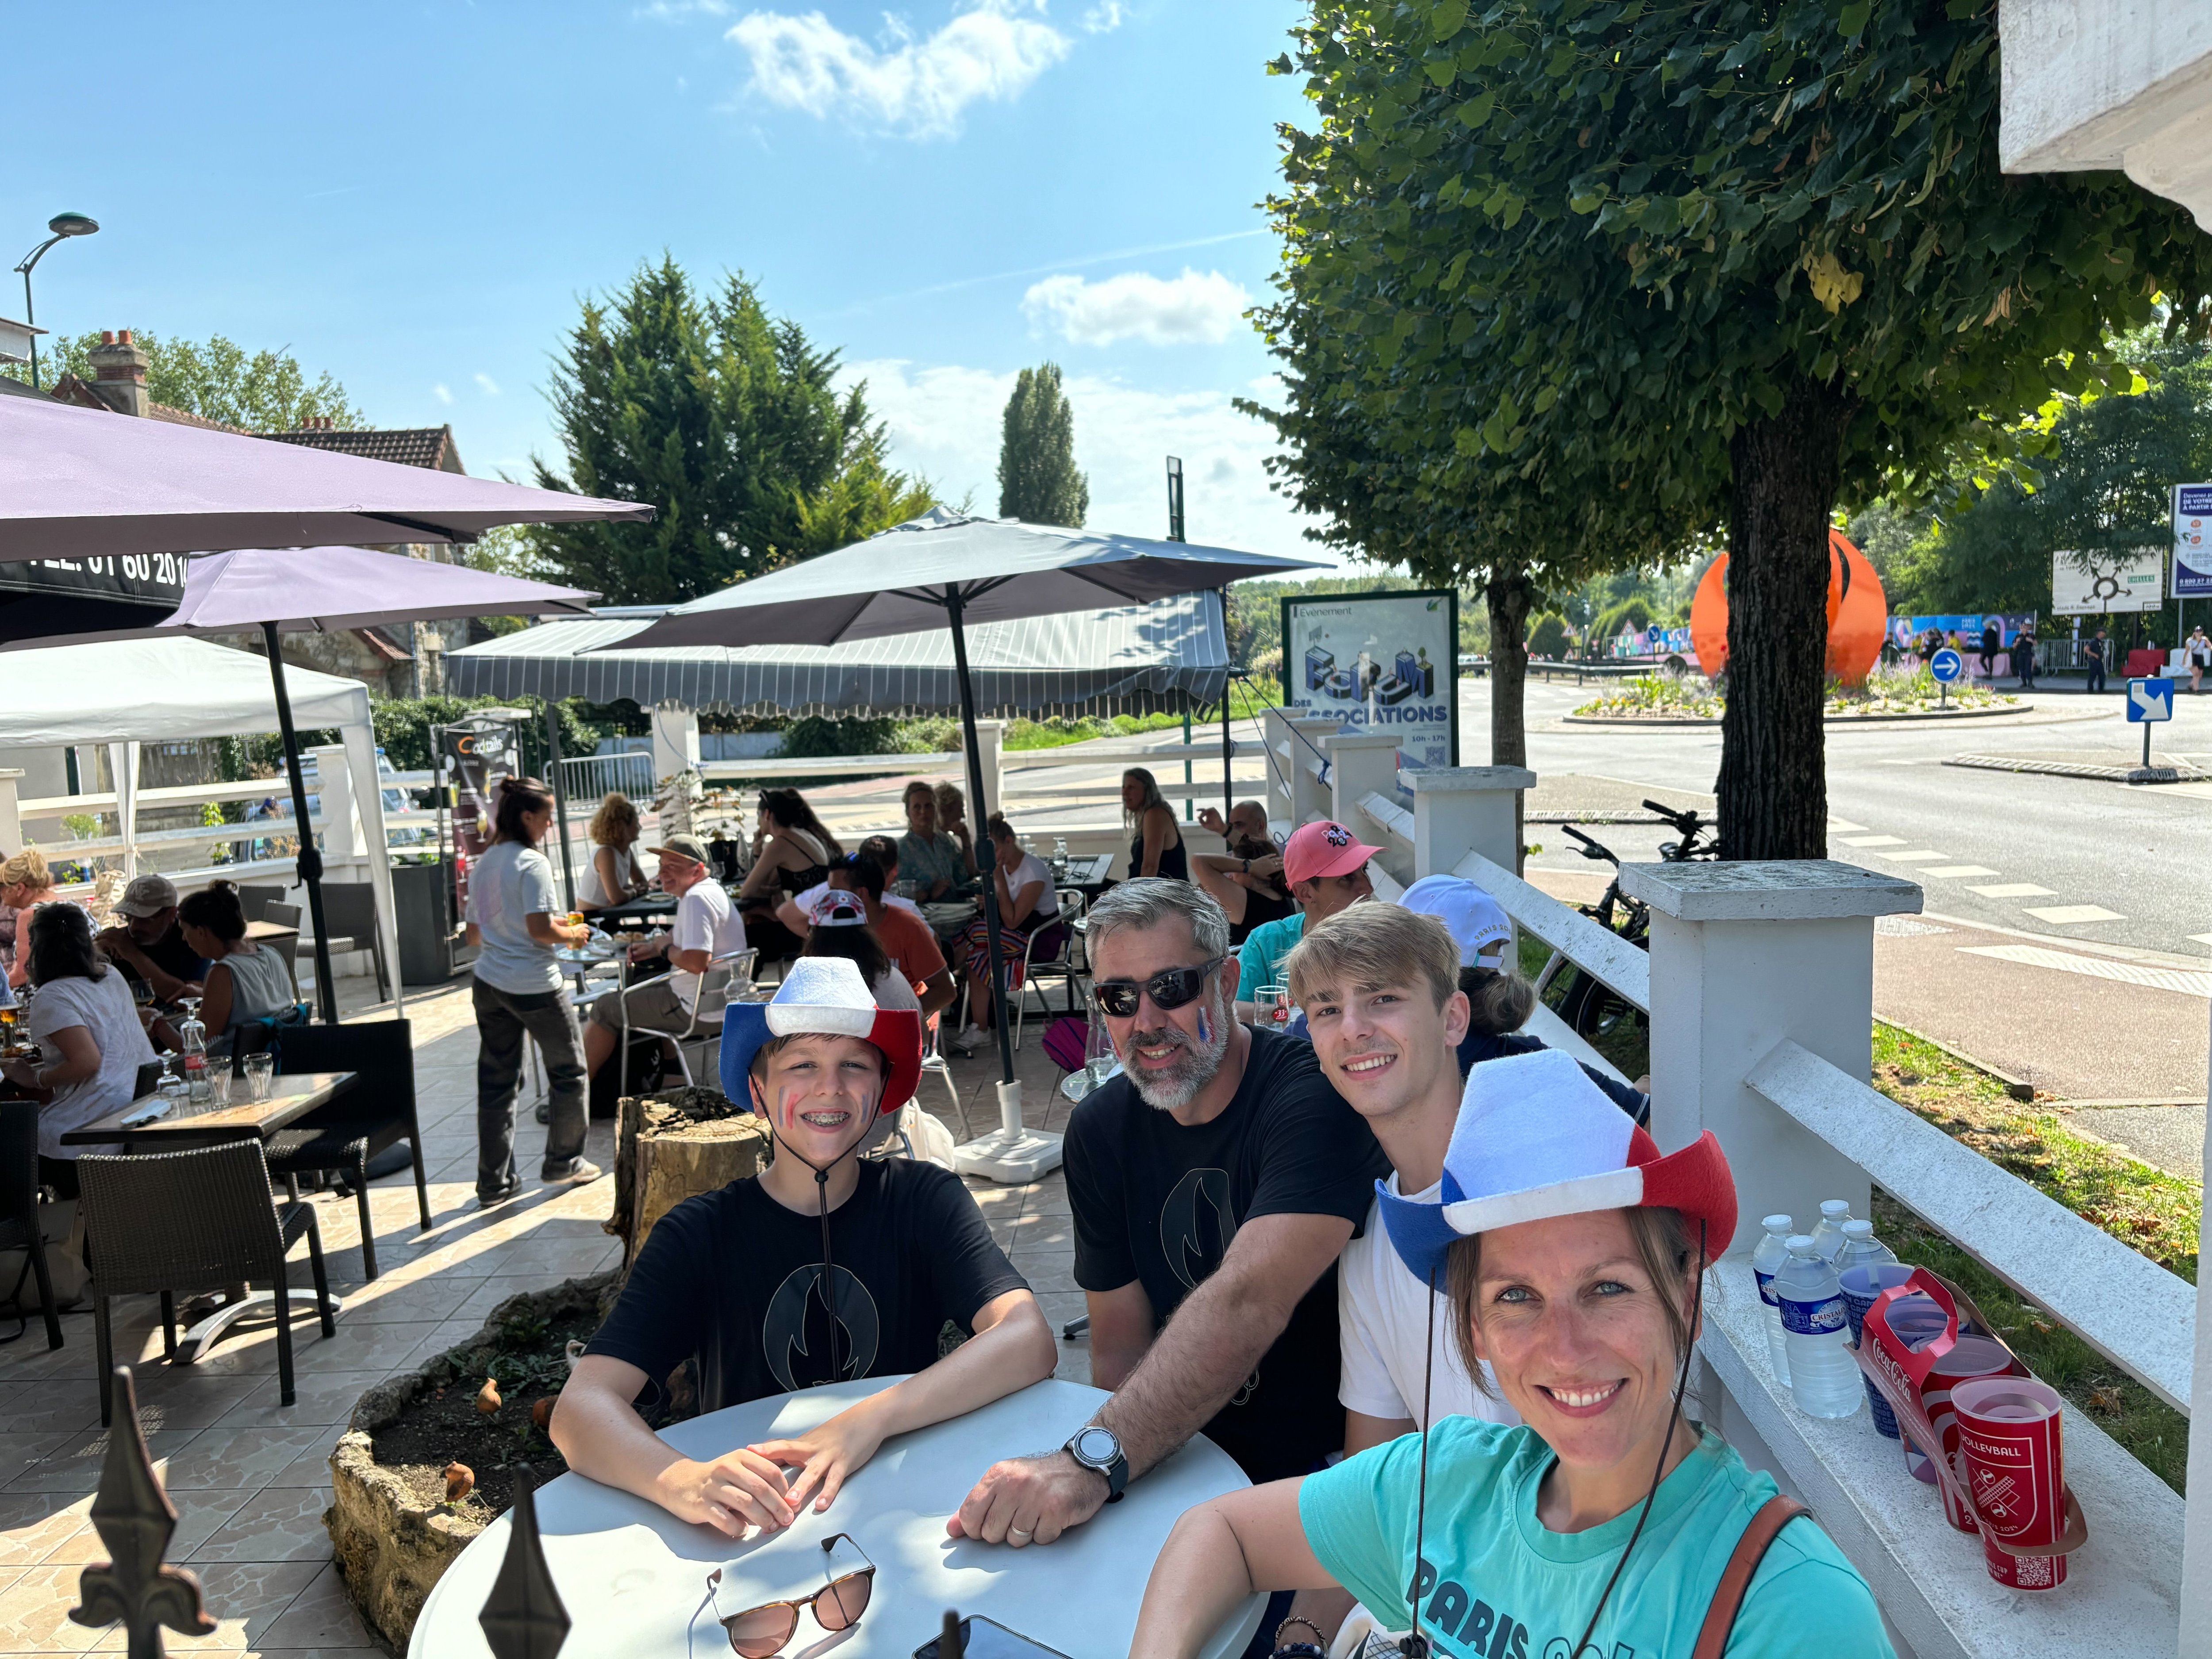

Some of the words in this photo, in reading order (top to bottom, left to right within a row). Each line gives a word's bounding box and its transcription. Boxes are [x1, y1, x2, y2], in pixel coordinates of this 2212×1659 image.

[153, 553, 176, 585] 20
[1308, 706, 1448, 725] SSOCIATIONS
[1961, 1433, 2021, 1457] VOLLEYBALL
[1405, 1557, 1528, 1659] PARIS
